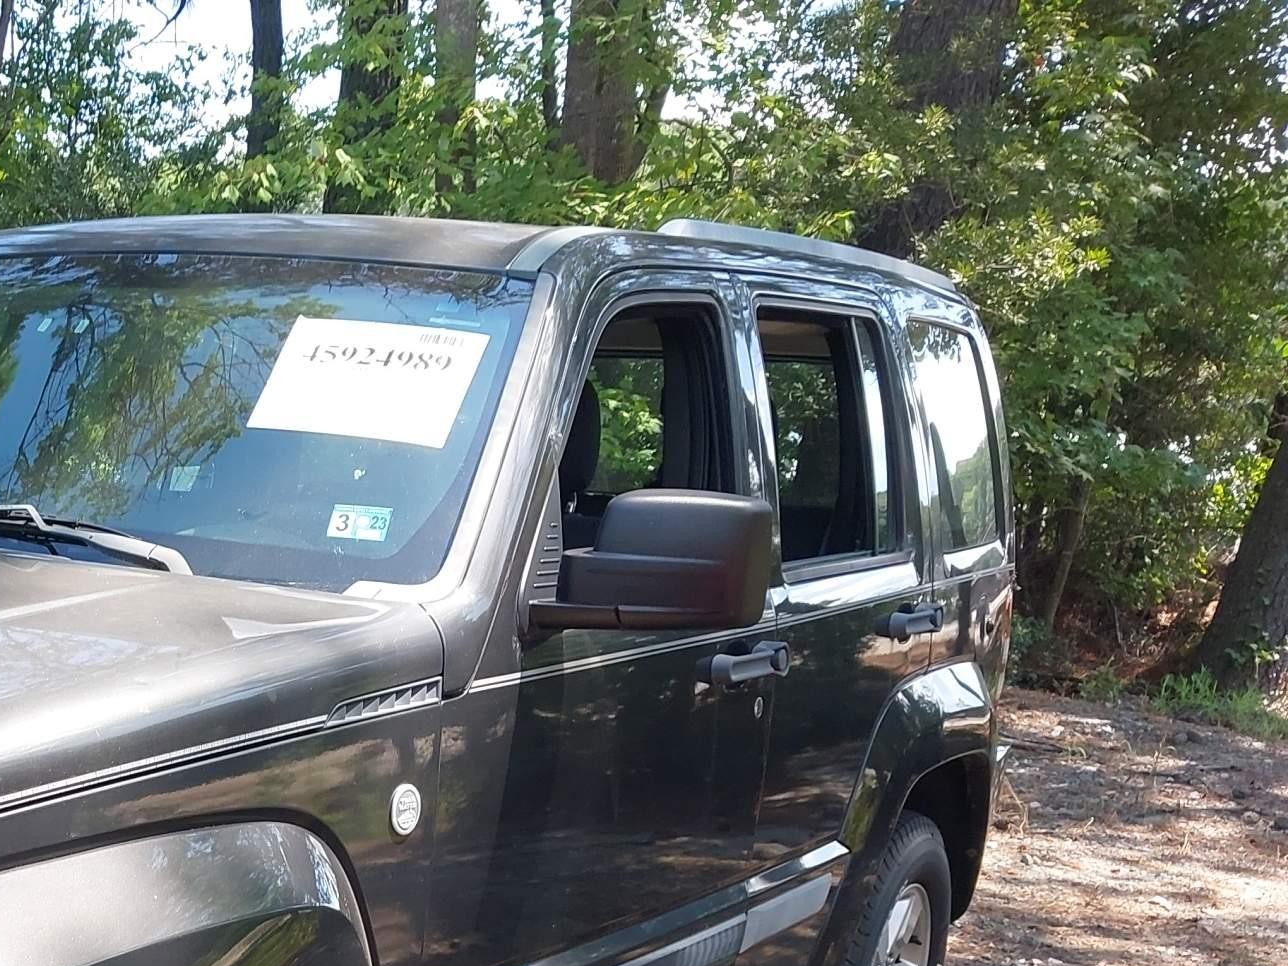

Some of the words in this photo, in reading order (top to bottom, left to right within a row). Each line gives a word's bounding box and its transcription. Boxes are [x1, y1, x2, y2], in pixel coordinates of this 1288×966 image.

[303, 344, 452, 371] 45924989
[335, 513, 350, 532] 3
[369, 515, 388, 531] 23
